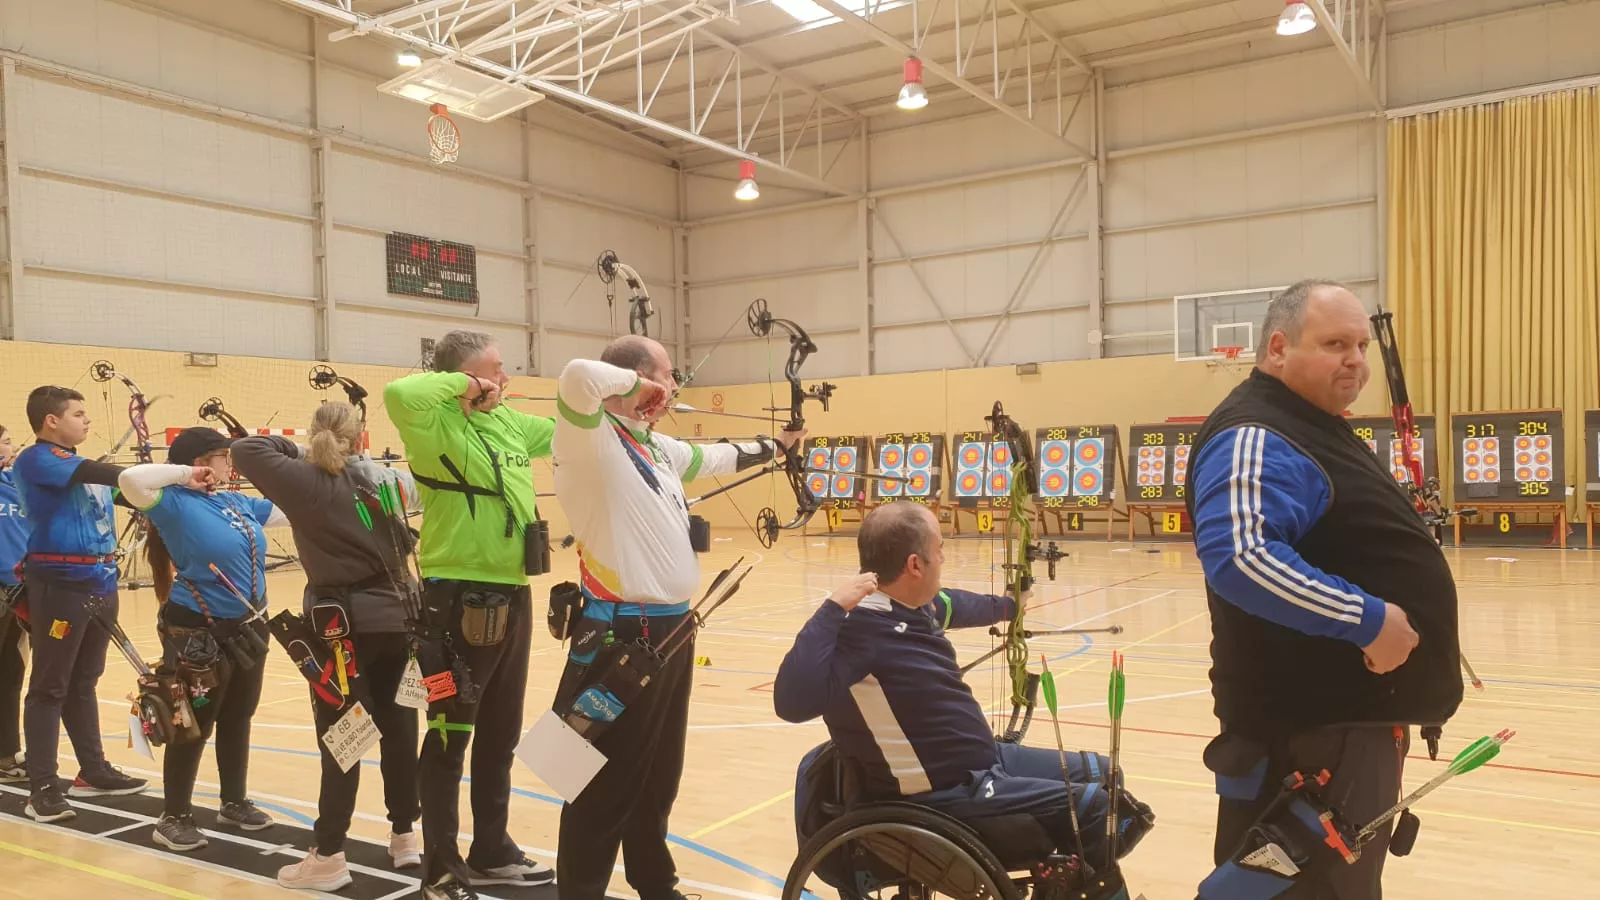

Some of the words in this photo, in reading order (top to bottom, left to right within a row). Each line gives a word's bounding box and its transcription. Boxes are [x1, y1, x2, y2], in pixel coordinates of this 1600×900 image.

[395, 263, 421, 276] LOCAL
[440, 270, 472, 283] VISITANTE
[1047, 429, 1067, 440] 280
[1079, 427, 1100, 438] 241
[1467, 424, 1495, 437] 317
[1519, 422, 1547, 435] 304
[963, 432, 983, 442] 241
[1143, 432, 1164, 445] 303
[1141, 486, 1162, 498] 283
[1520, 482, 1549, 495] 305
[1044, 496, 1064, 507] 302
[1077, 496, 1098, 507] 298
[832, 513, 838, 525] 1
[982, 514, 989, 528] 3
[1071, 513, 1079, 529] 4
[1168, 514, 1175, 530] 5
[1500, 513, 1510, 532] 8
